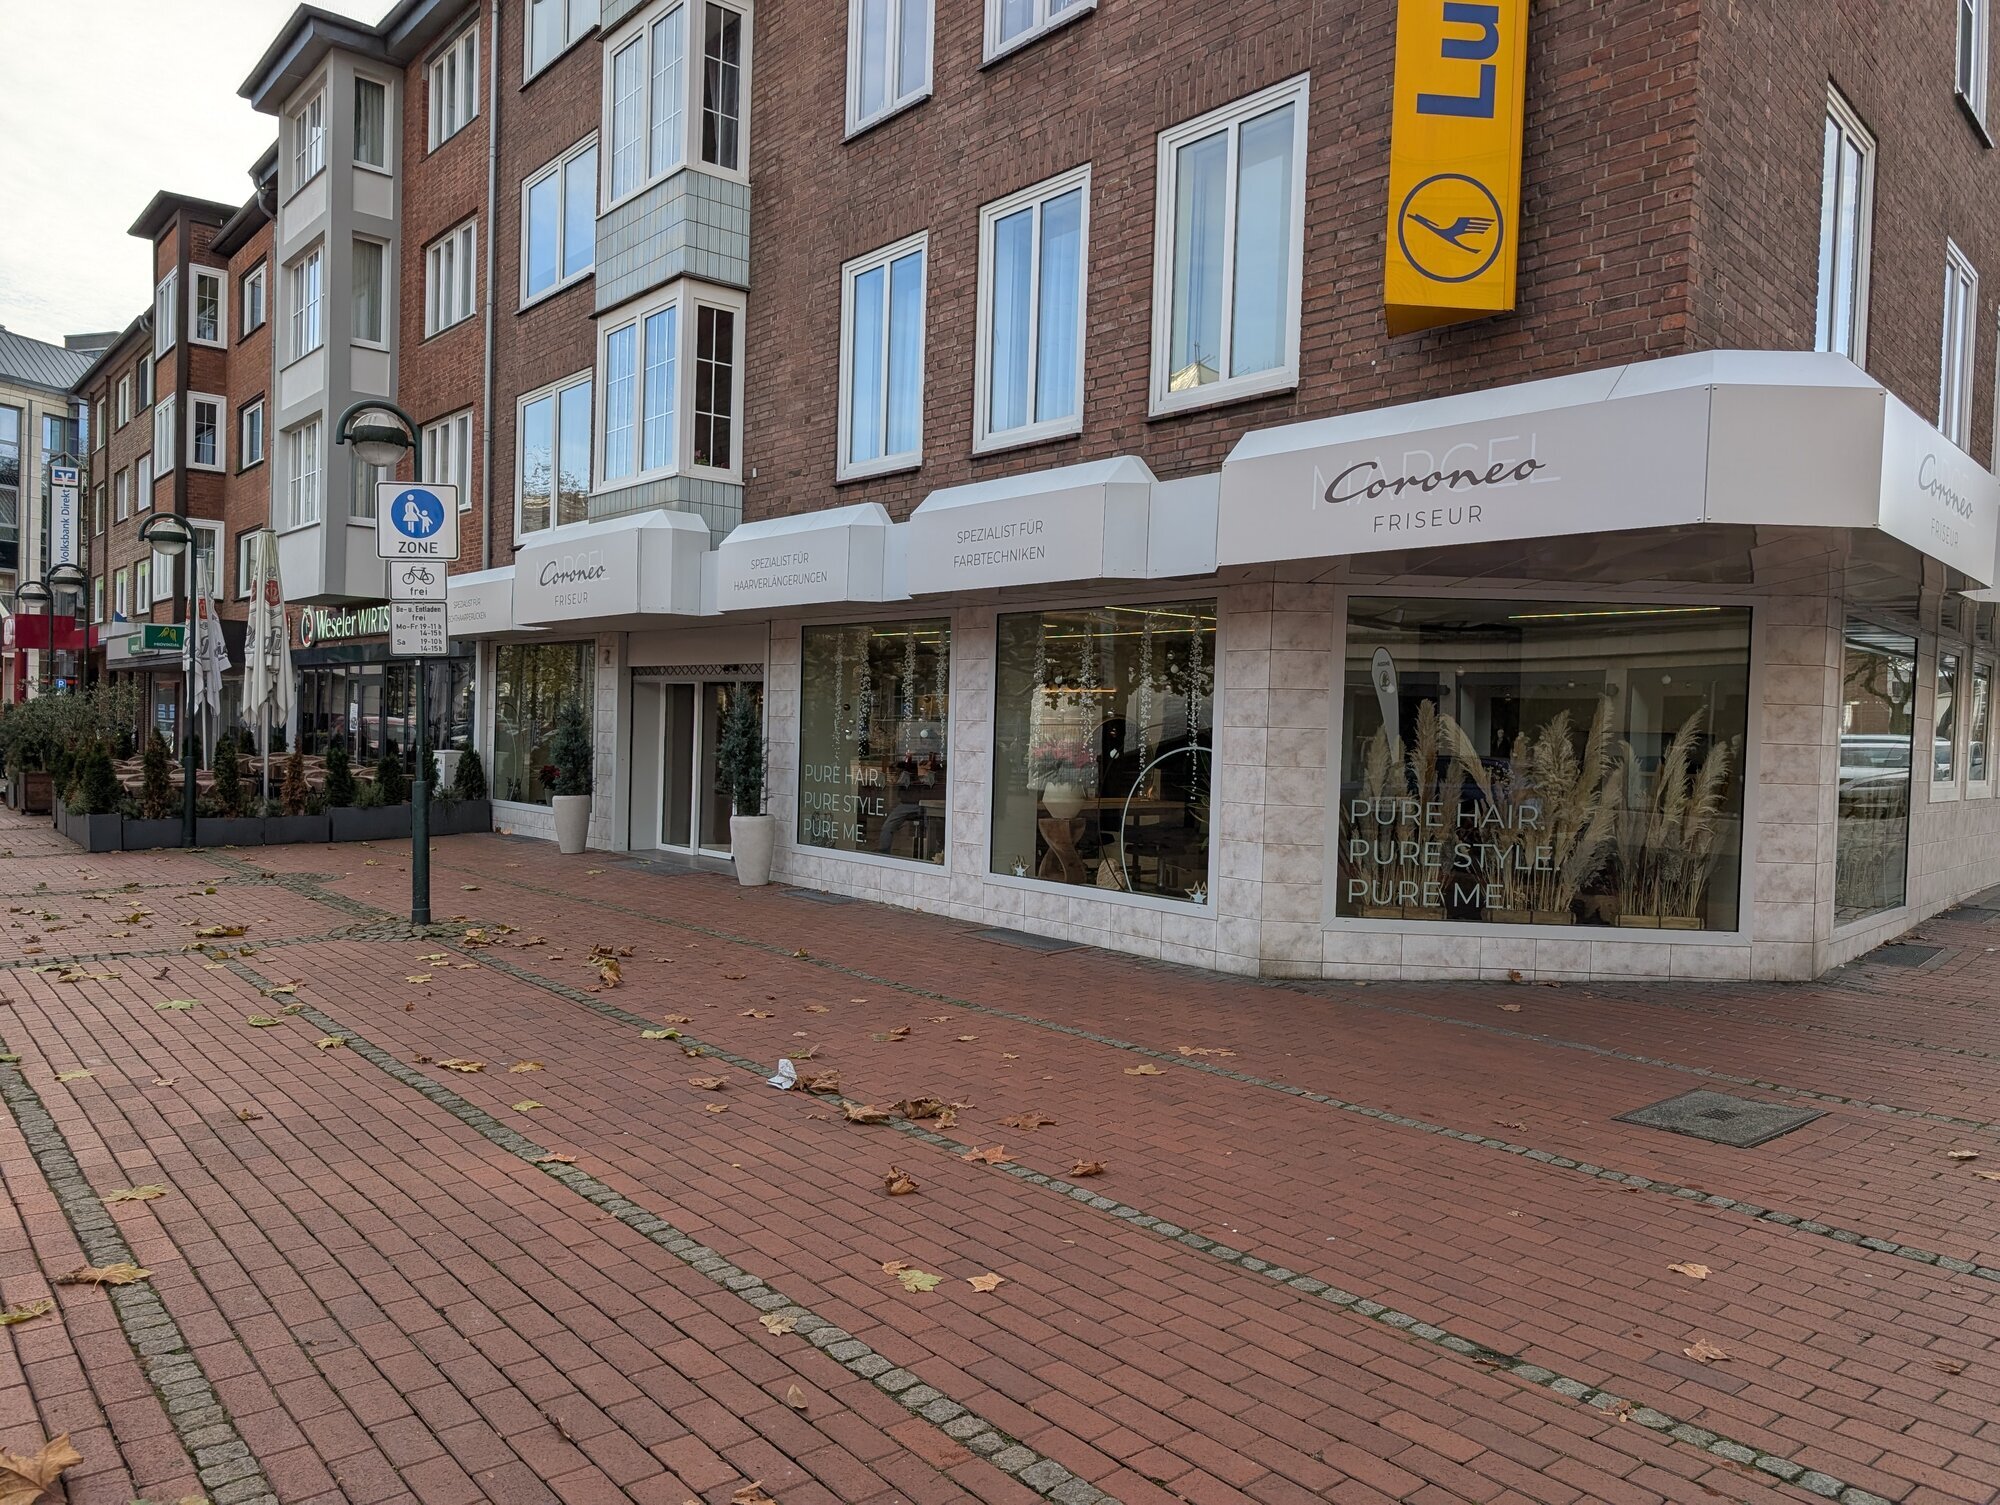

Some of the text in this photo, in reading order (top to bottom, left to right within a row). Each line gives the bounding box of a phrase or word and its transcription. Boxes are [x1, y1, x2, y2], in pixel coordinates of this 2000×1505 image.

[1324, 458, 1546, 503] Coroneo
[1918, 453, 1973, 519] Coroneo
[60, 489, 70, 563] Volksbank Direkt
[957, 518, 1044, 544] SPEZIALIST FÜR
[1373, 505, 1482, 533] FRISEUR
[398, 541, 438, 553] ZONE
[953, 545, 1045, 568] FARBTECHNIKEN
[539, 560, 606, 587] Coroneo
[750, 551, 809, 570] SPEZIALIST FÜR
[409, 586, 428, 596] frei
[733, 571, 828, 591] HAARVERLÄNGERUNGEN
[554, 592, 588, 606] FRISEUR
[316, 607, 357, 639] Weseler
[358, 605, 390, 634] WIRTS
[804, 764, 881, 787] PURE HAIR.
[804, 791, 888, 817] PURE STYLE.
[1350, 800, 1546, 831] PURE HAIR.
[803, 818, 867, 843] PURE ME.
[1349, 839, 1561, 871] PURE STYLE.
[1348, 879, 1511, 910] PURE ME.
